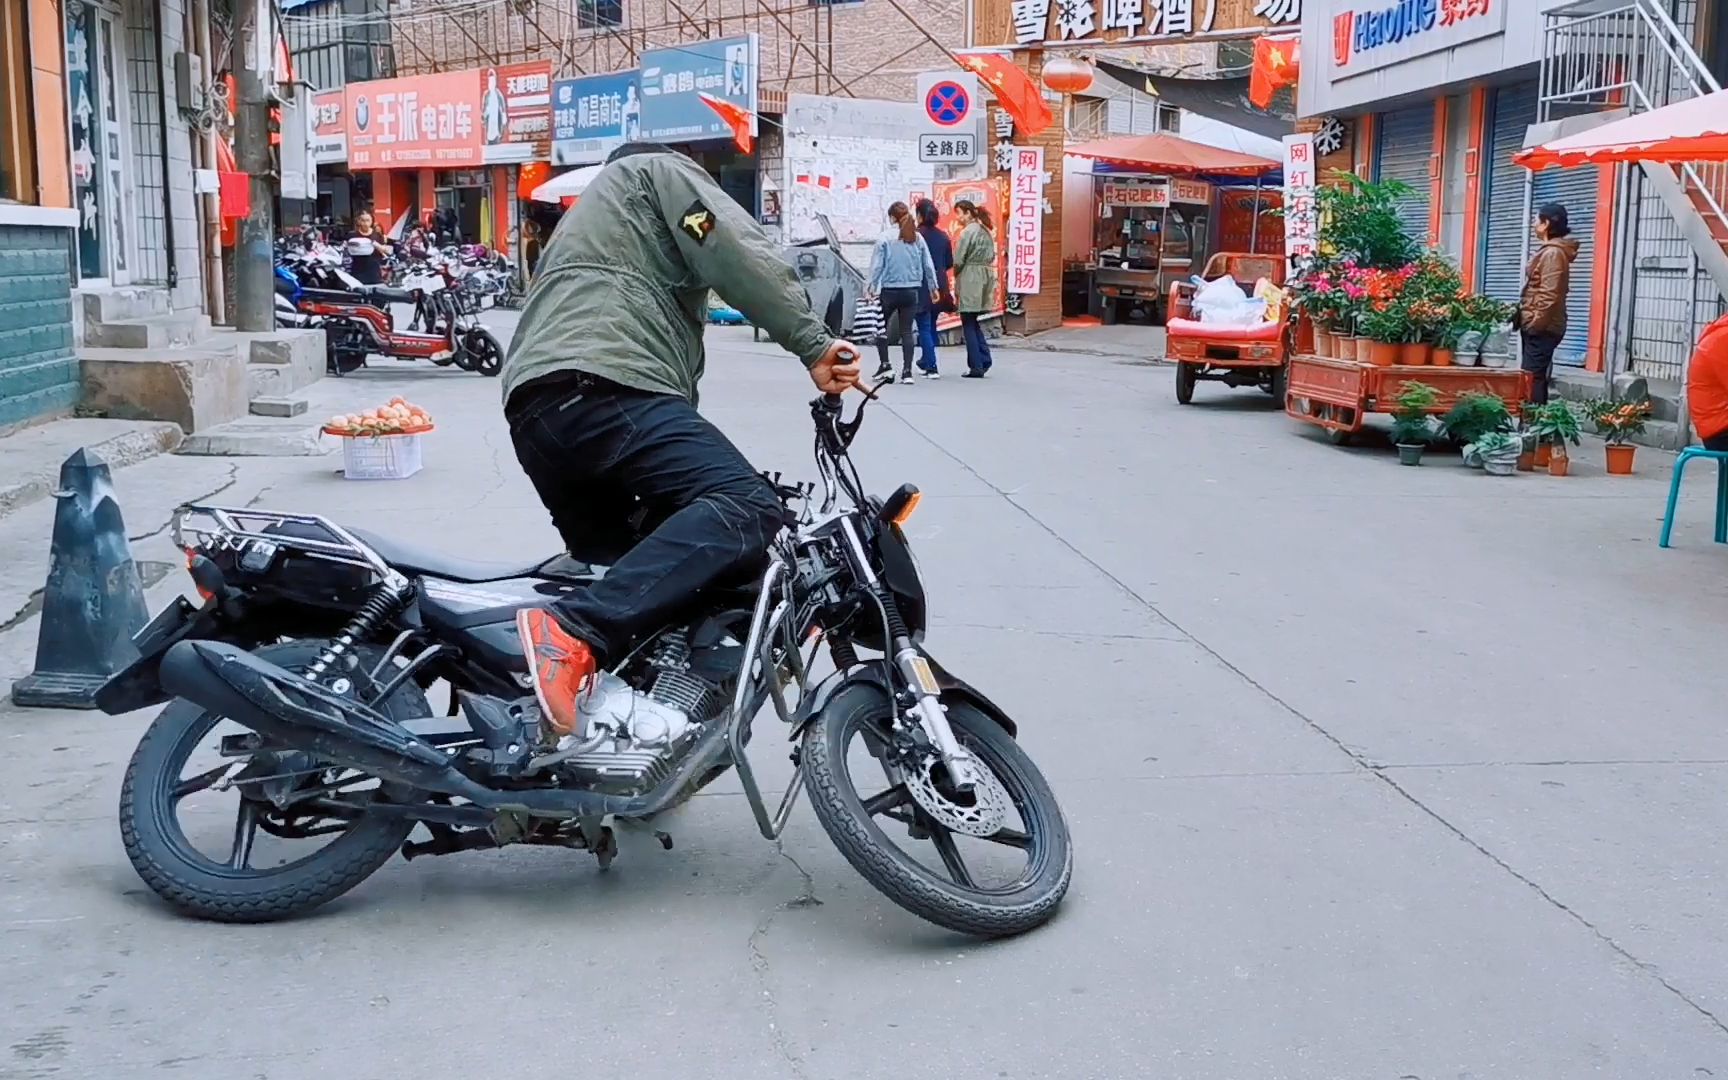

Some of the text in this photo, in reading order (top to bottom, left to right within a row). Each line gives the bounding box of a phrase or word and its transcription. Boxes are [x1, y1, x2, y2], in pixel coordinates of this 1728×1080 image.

[376, 92, 472, 143] 王派电动车
[578, 92, 622, 129] 顺昌商店
[926, 140, 969, 156] 全路段
[1014, 150, 1037, 288] 网红石记肥肠
